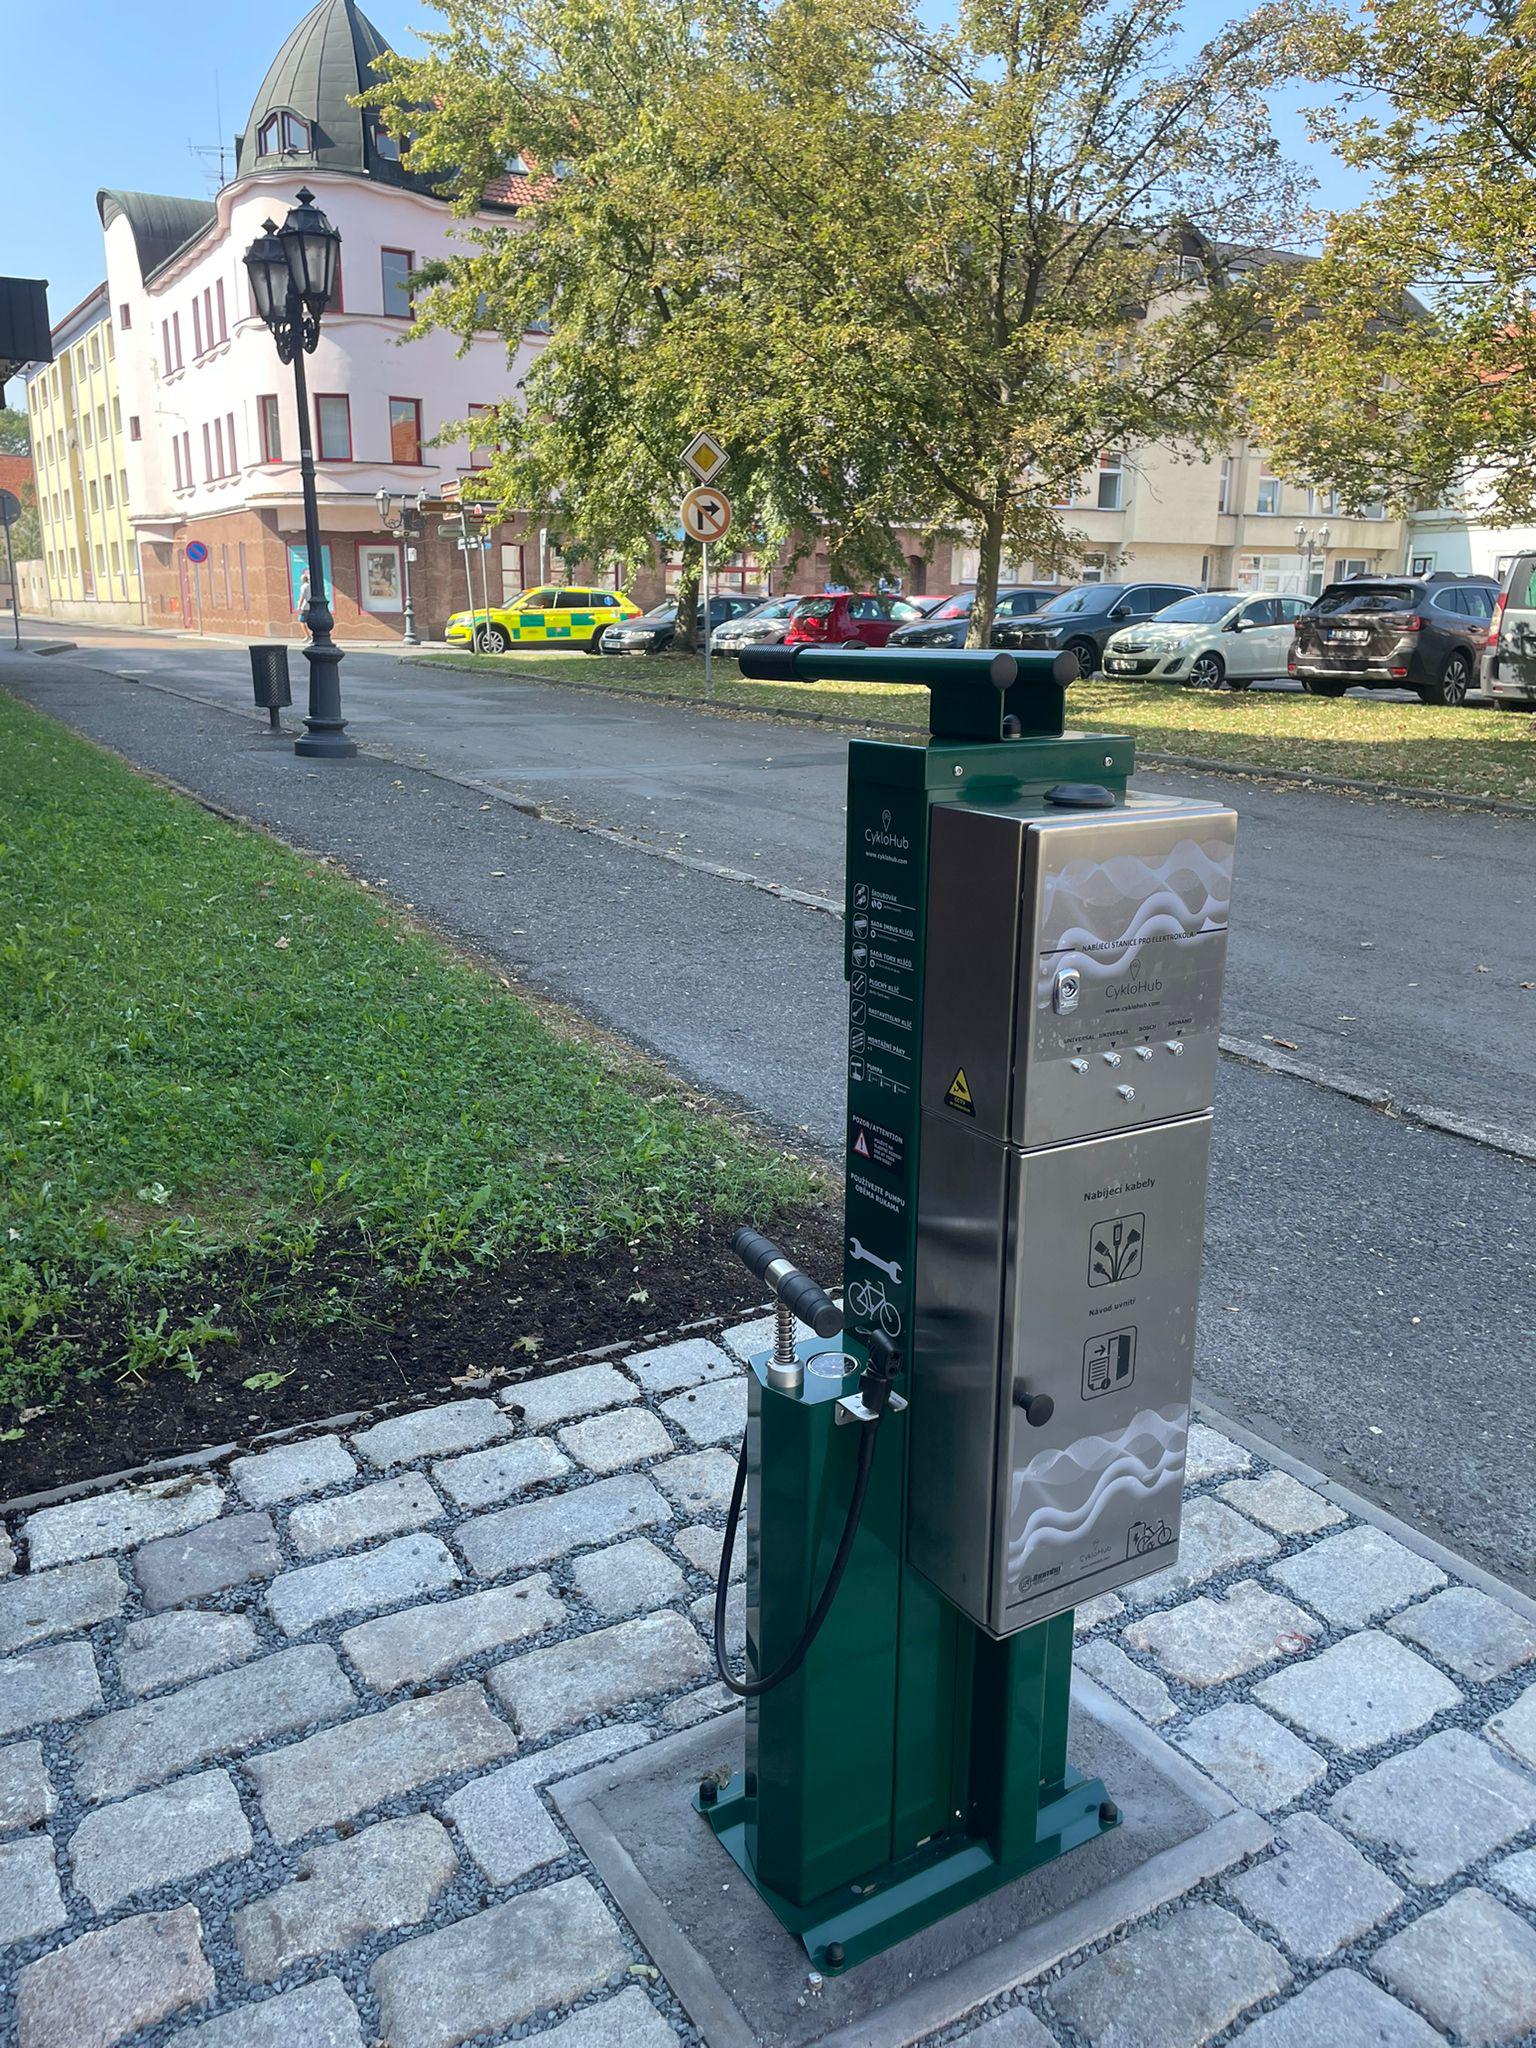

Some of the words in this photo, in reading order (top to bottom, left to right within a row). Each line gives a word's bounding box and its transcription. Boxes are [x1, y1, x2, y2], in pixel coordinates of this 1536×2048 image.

[865, 828, 909, 849] CykloHub
[870, 920, 883, 929] SADA
[1111, 939, 1137, 948] STANICE
[1138, 937, 1151, 945] PRO
[1151, 931, 1194, 943] ELEKTROKOLA
[869, 949, 883, 958] SADA
[883, 953, 896, 962] TORX
[1105, 979, 1162, 1000] CykloHub
[1063, 1035, 1095, 1044] UNIVERSAL
[1098, 1030, 1129, 1038] UNIVERSAL
[866, 1063, 883, 1074] PUMPA
[852, 1114, 904, 1144] POZOR/ATTENTION
[850, 1172, 884, 1195] POUŽÍVEJTE
[884, 1190, 905, 1206] PUMPU
[1125, 1178, 1155, 1192] kabely
[855, 1184, 875, 1200] OBĚMA
[875, 1196, 900, 1214] RUKAMA
[1089, 1303, 1112, 1316] Návod
